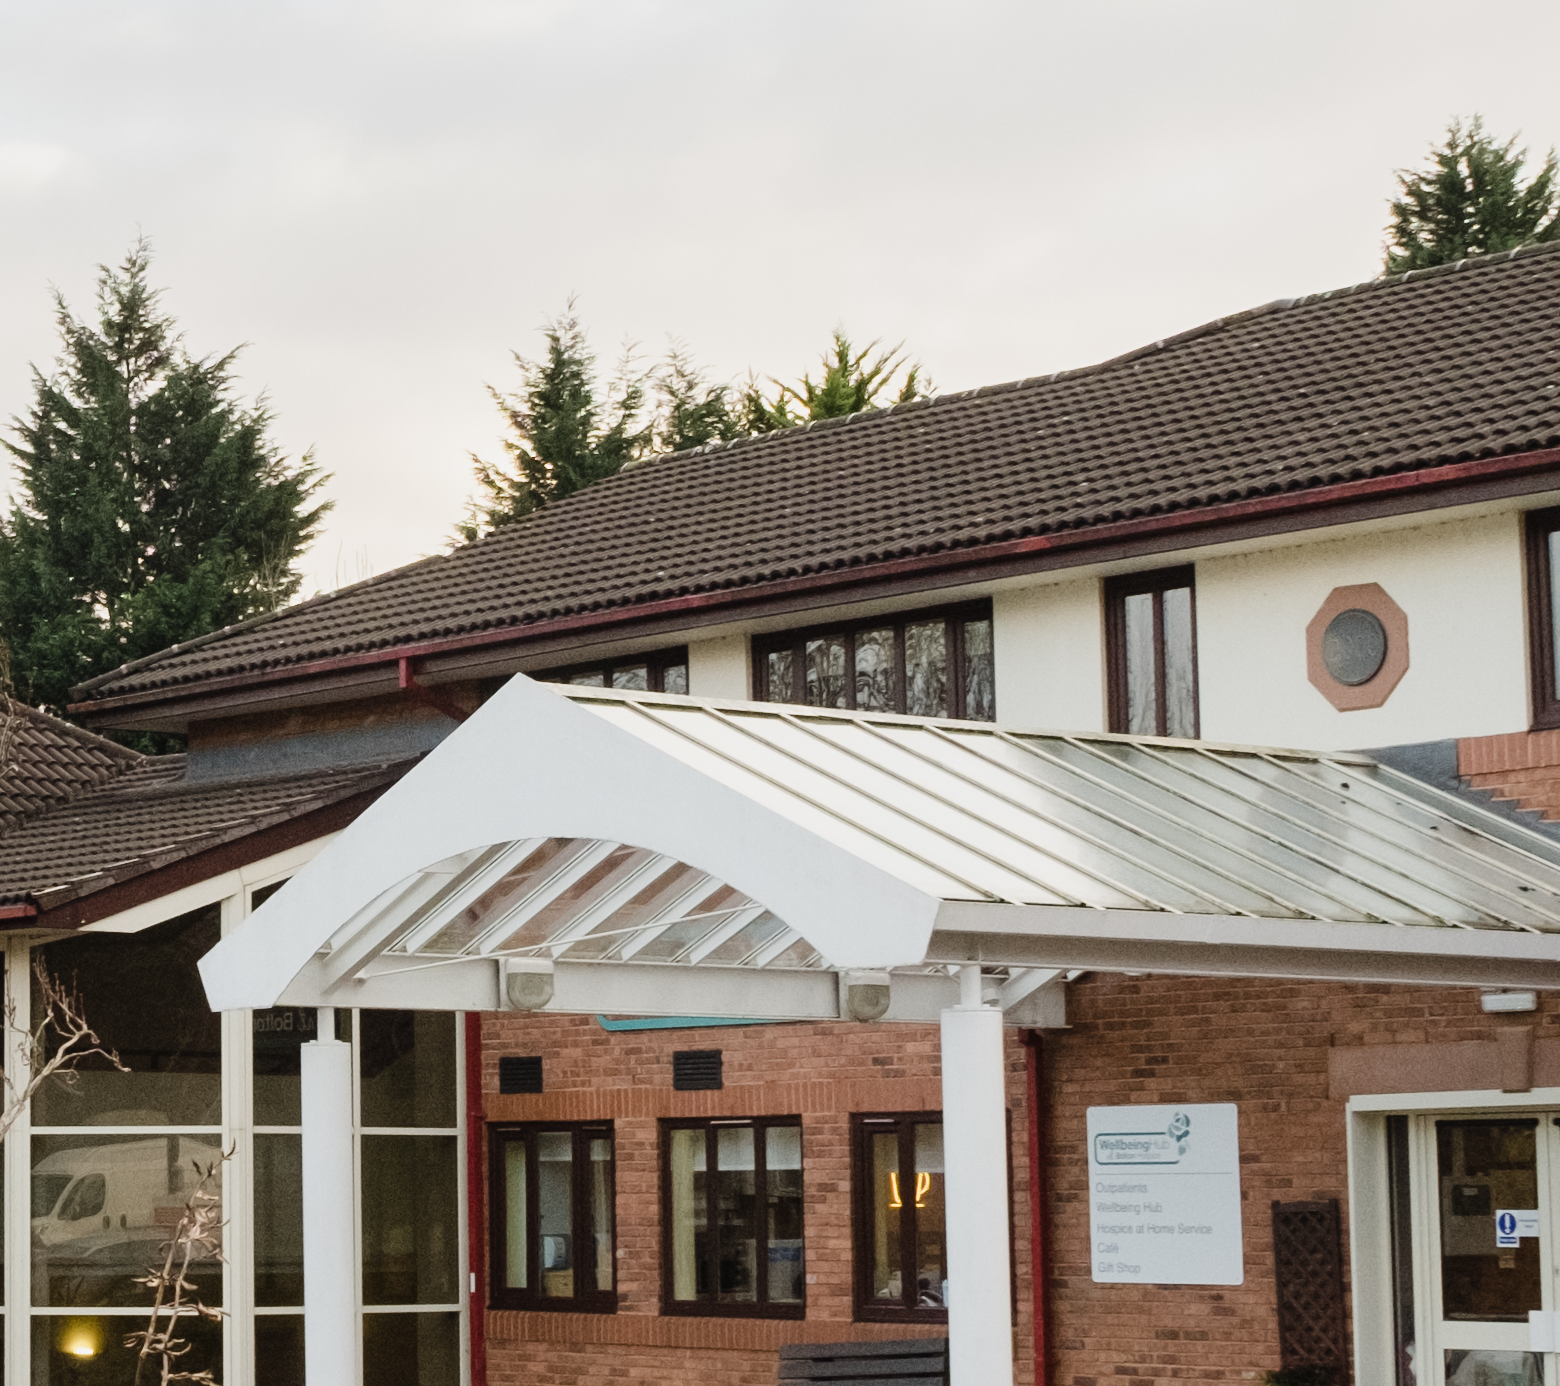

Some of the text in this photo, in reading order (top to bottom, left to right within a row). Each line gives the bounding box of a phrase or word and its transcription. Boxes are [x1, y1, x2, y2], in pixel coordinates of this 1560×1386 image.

[1095, 1182, 1148, 1195] Outpatients
[1096, 1202, 1163, 1215] Wellbeing Hub
[1096, 1222, 1213, 1235] Hospice at Home Service
[1097, 1262, 1141, 1275] Gift Shop
